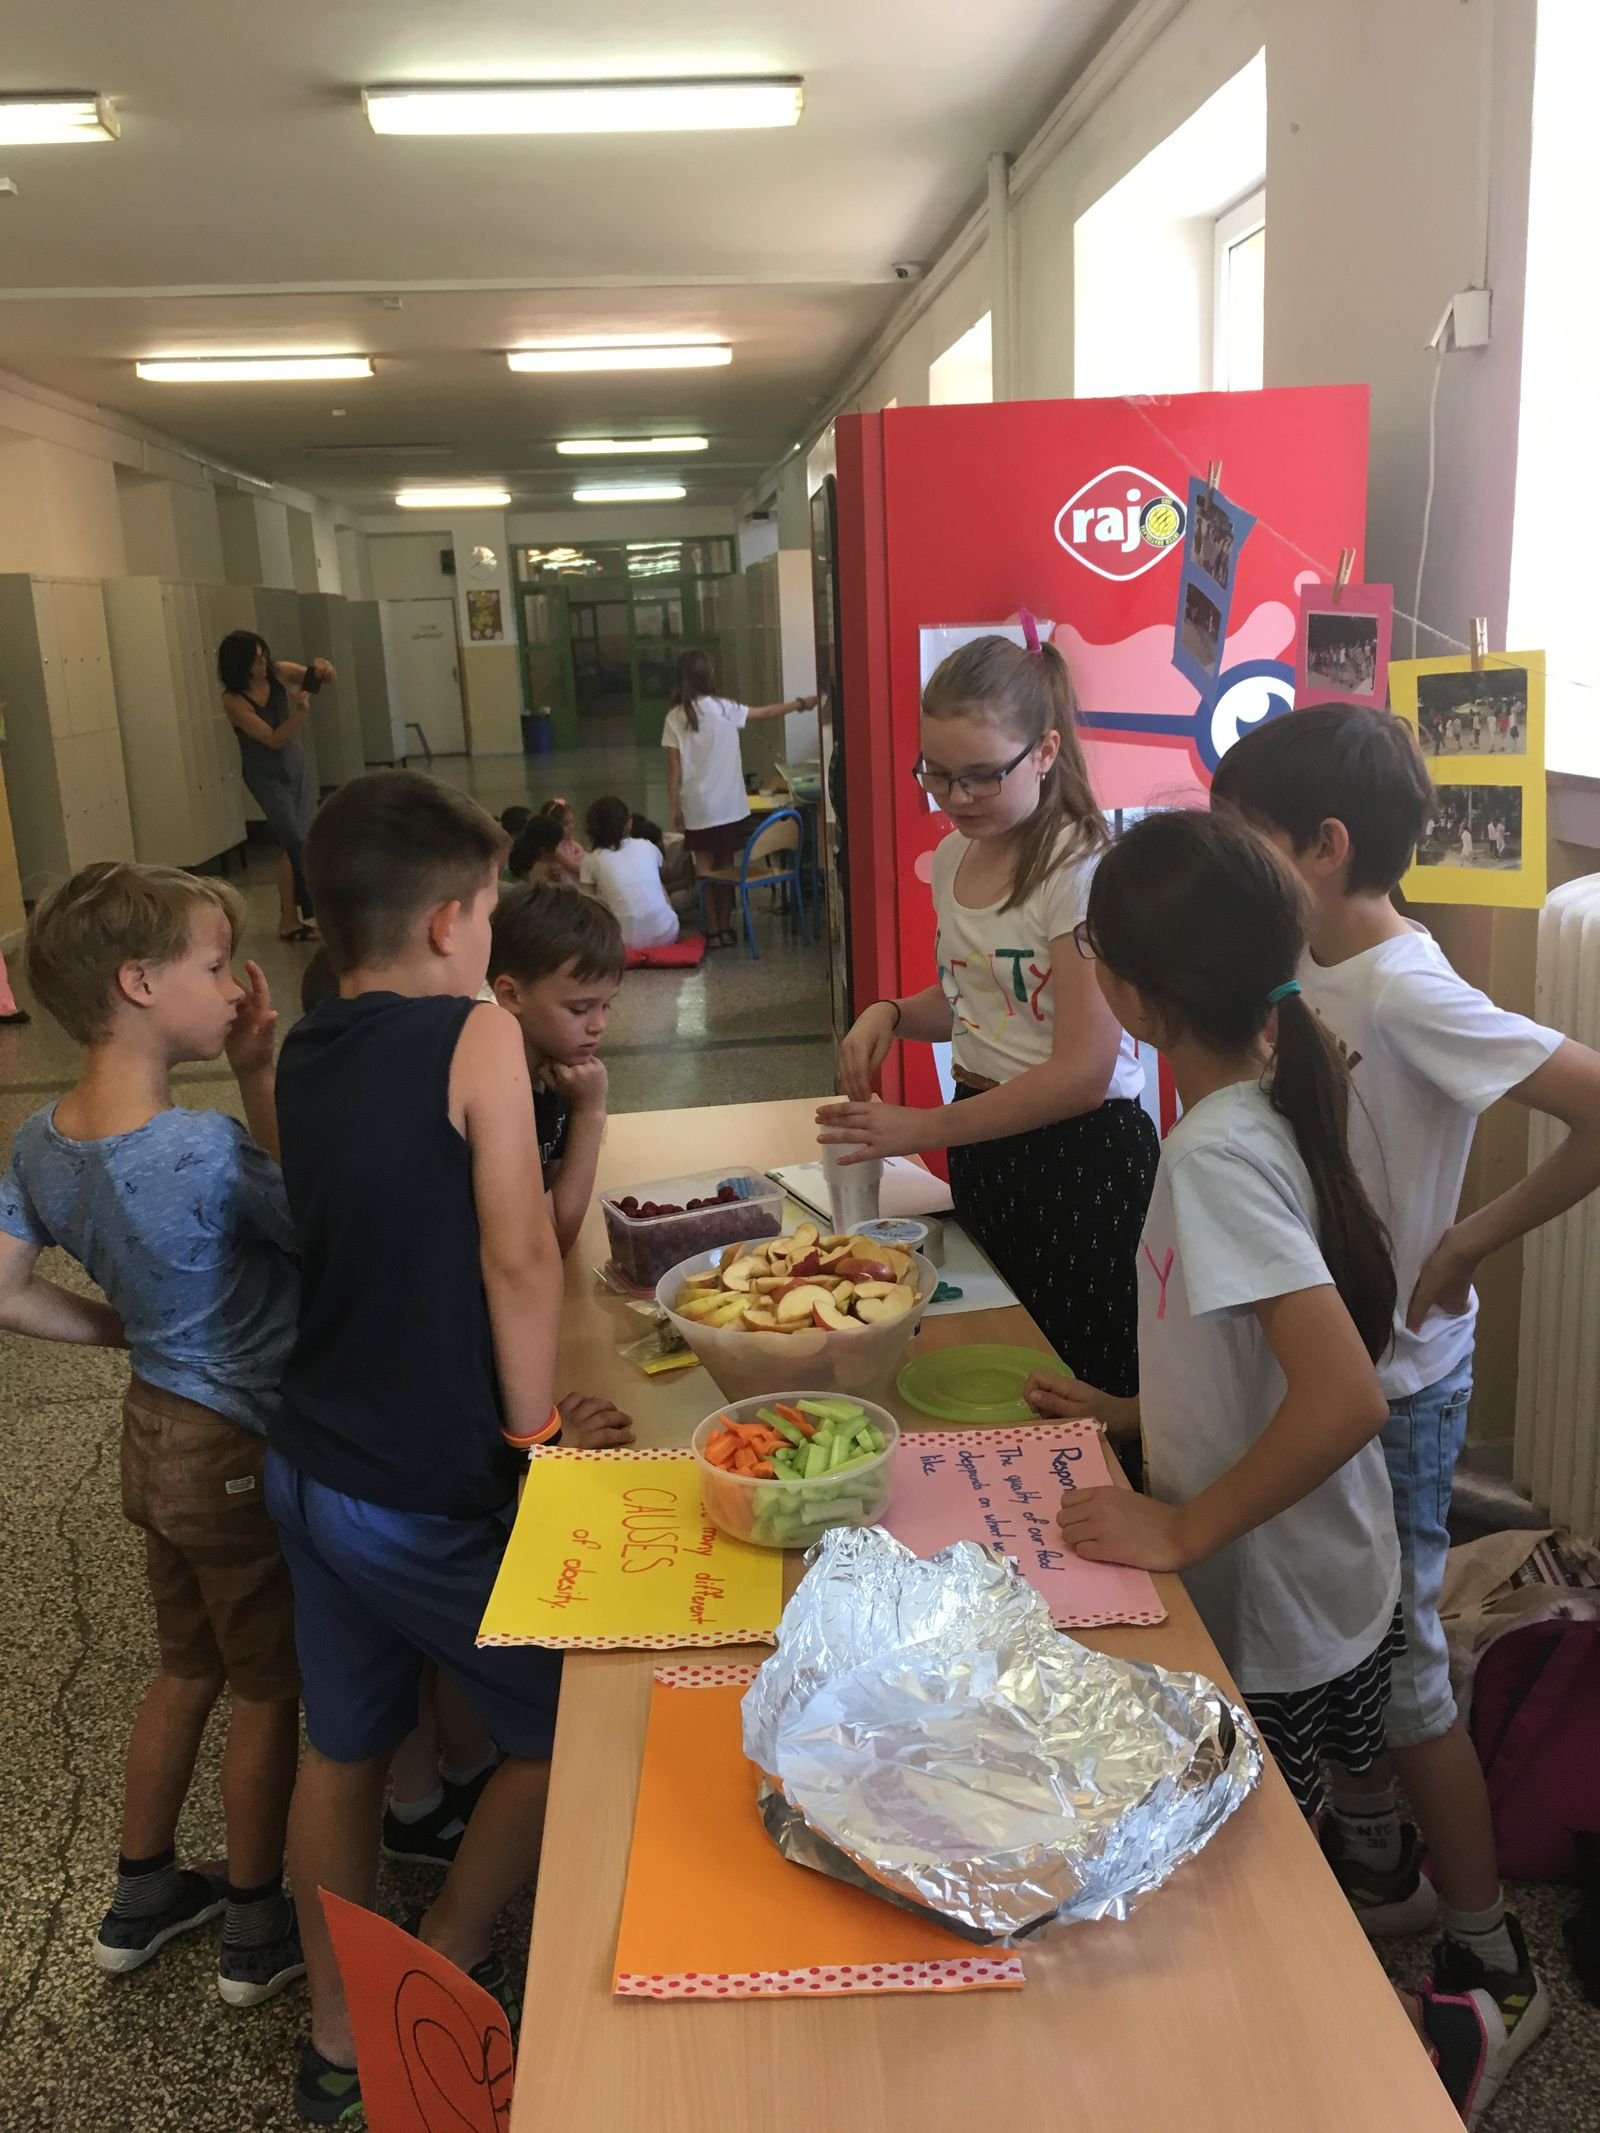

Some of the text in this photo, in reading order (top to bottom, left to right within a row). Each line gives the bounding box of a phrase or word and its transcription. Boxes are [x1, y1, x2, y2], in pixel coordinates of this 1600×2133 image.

[996, 1445, 1023, 1467] The
[1022, 1511, 1049, 1525] of
[572, 1529, 602, 1550] of
[621, 1488, 680, 1573] CAUSES
[683, 1527, 717, 1556] many
[1027, 1527, 1044, 1546] our
[1036, 1549, 1065, 1571] food
